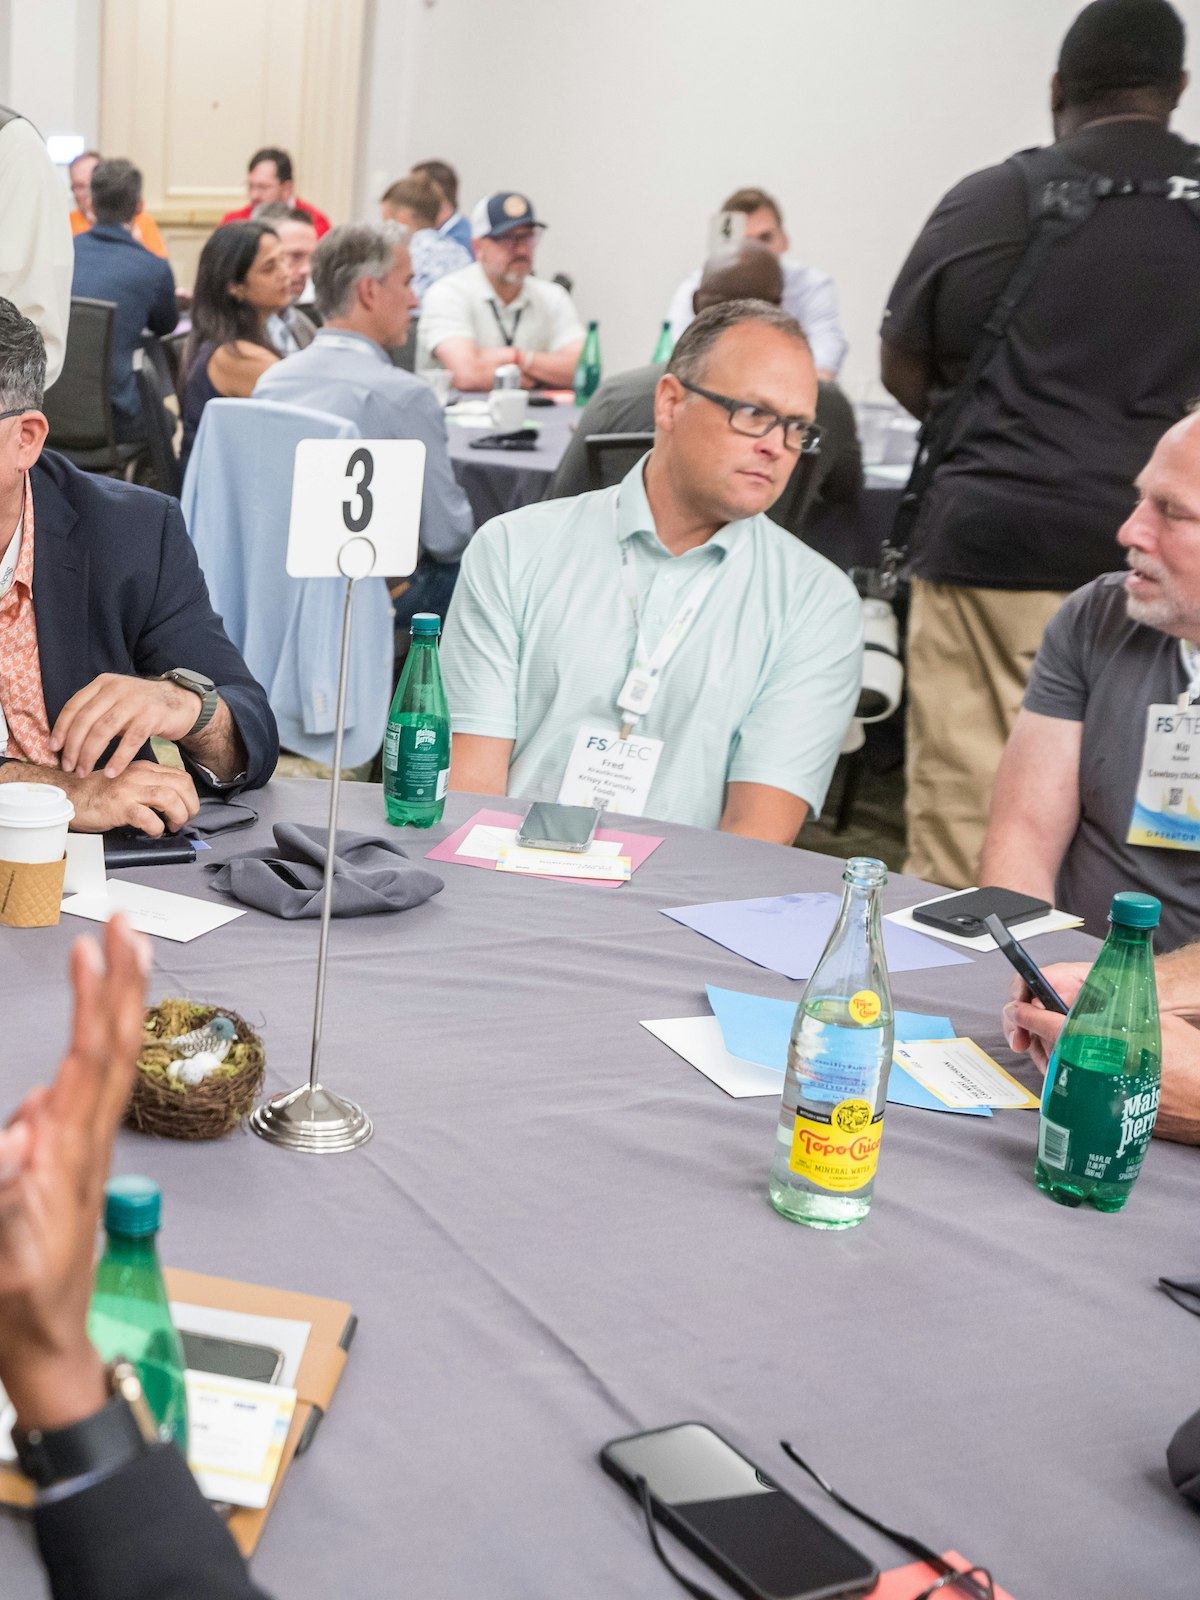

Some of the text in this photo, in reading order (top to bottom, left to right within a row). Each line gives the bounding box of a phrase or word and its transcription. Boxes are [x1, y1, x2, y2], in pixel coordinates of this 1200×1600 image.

[342, 447, 374, 532] 3
[586, 736, 652, 761] FS/TEC
[602, 758, 624, 770] Fred
[799, 1129, 846, 1156] Topo
[814, 1165, 870, 1175] MINERAL WATER
